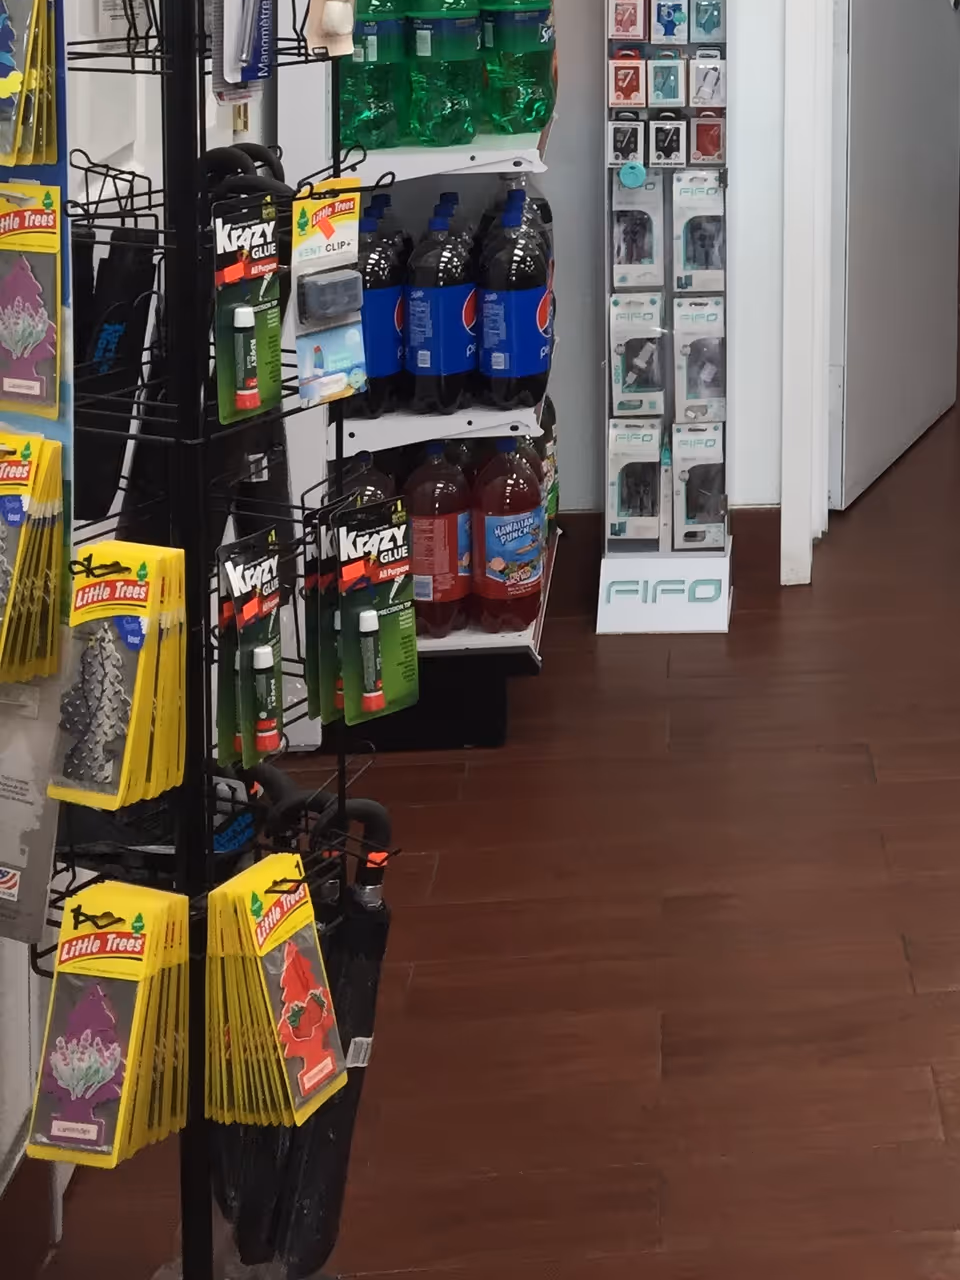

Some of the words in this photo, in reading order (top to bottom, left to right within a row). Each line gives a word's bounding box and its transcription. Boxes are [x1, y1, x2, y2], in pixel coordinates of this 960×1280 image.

[258, 3, 271, 77] Manomètre
[334, 201, 354, 212] Trees
[24, 211, 55, 228] Trees
[251, 242, 277, 259] GLUE
[615, 433, 653, 443] FIFO
[678, 438, 716, 449] FIFO
[494, 517, 534, 537] HAWAIIAN
[500, 526, 531, 545] PUNCH
[380, 545, 409, 564] GLUE
[75, 582, 110, 608] Little
[114, 581, 147, 600] Trees
[605, 578, 722, 604] FIFO
[256, 906, 281, 945] Little
[61, 934, 101, 961] Little
[106, 933, 144, 953] Trees
